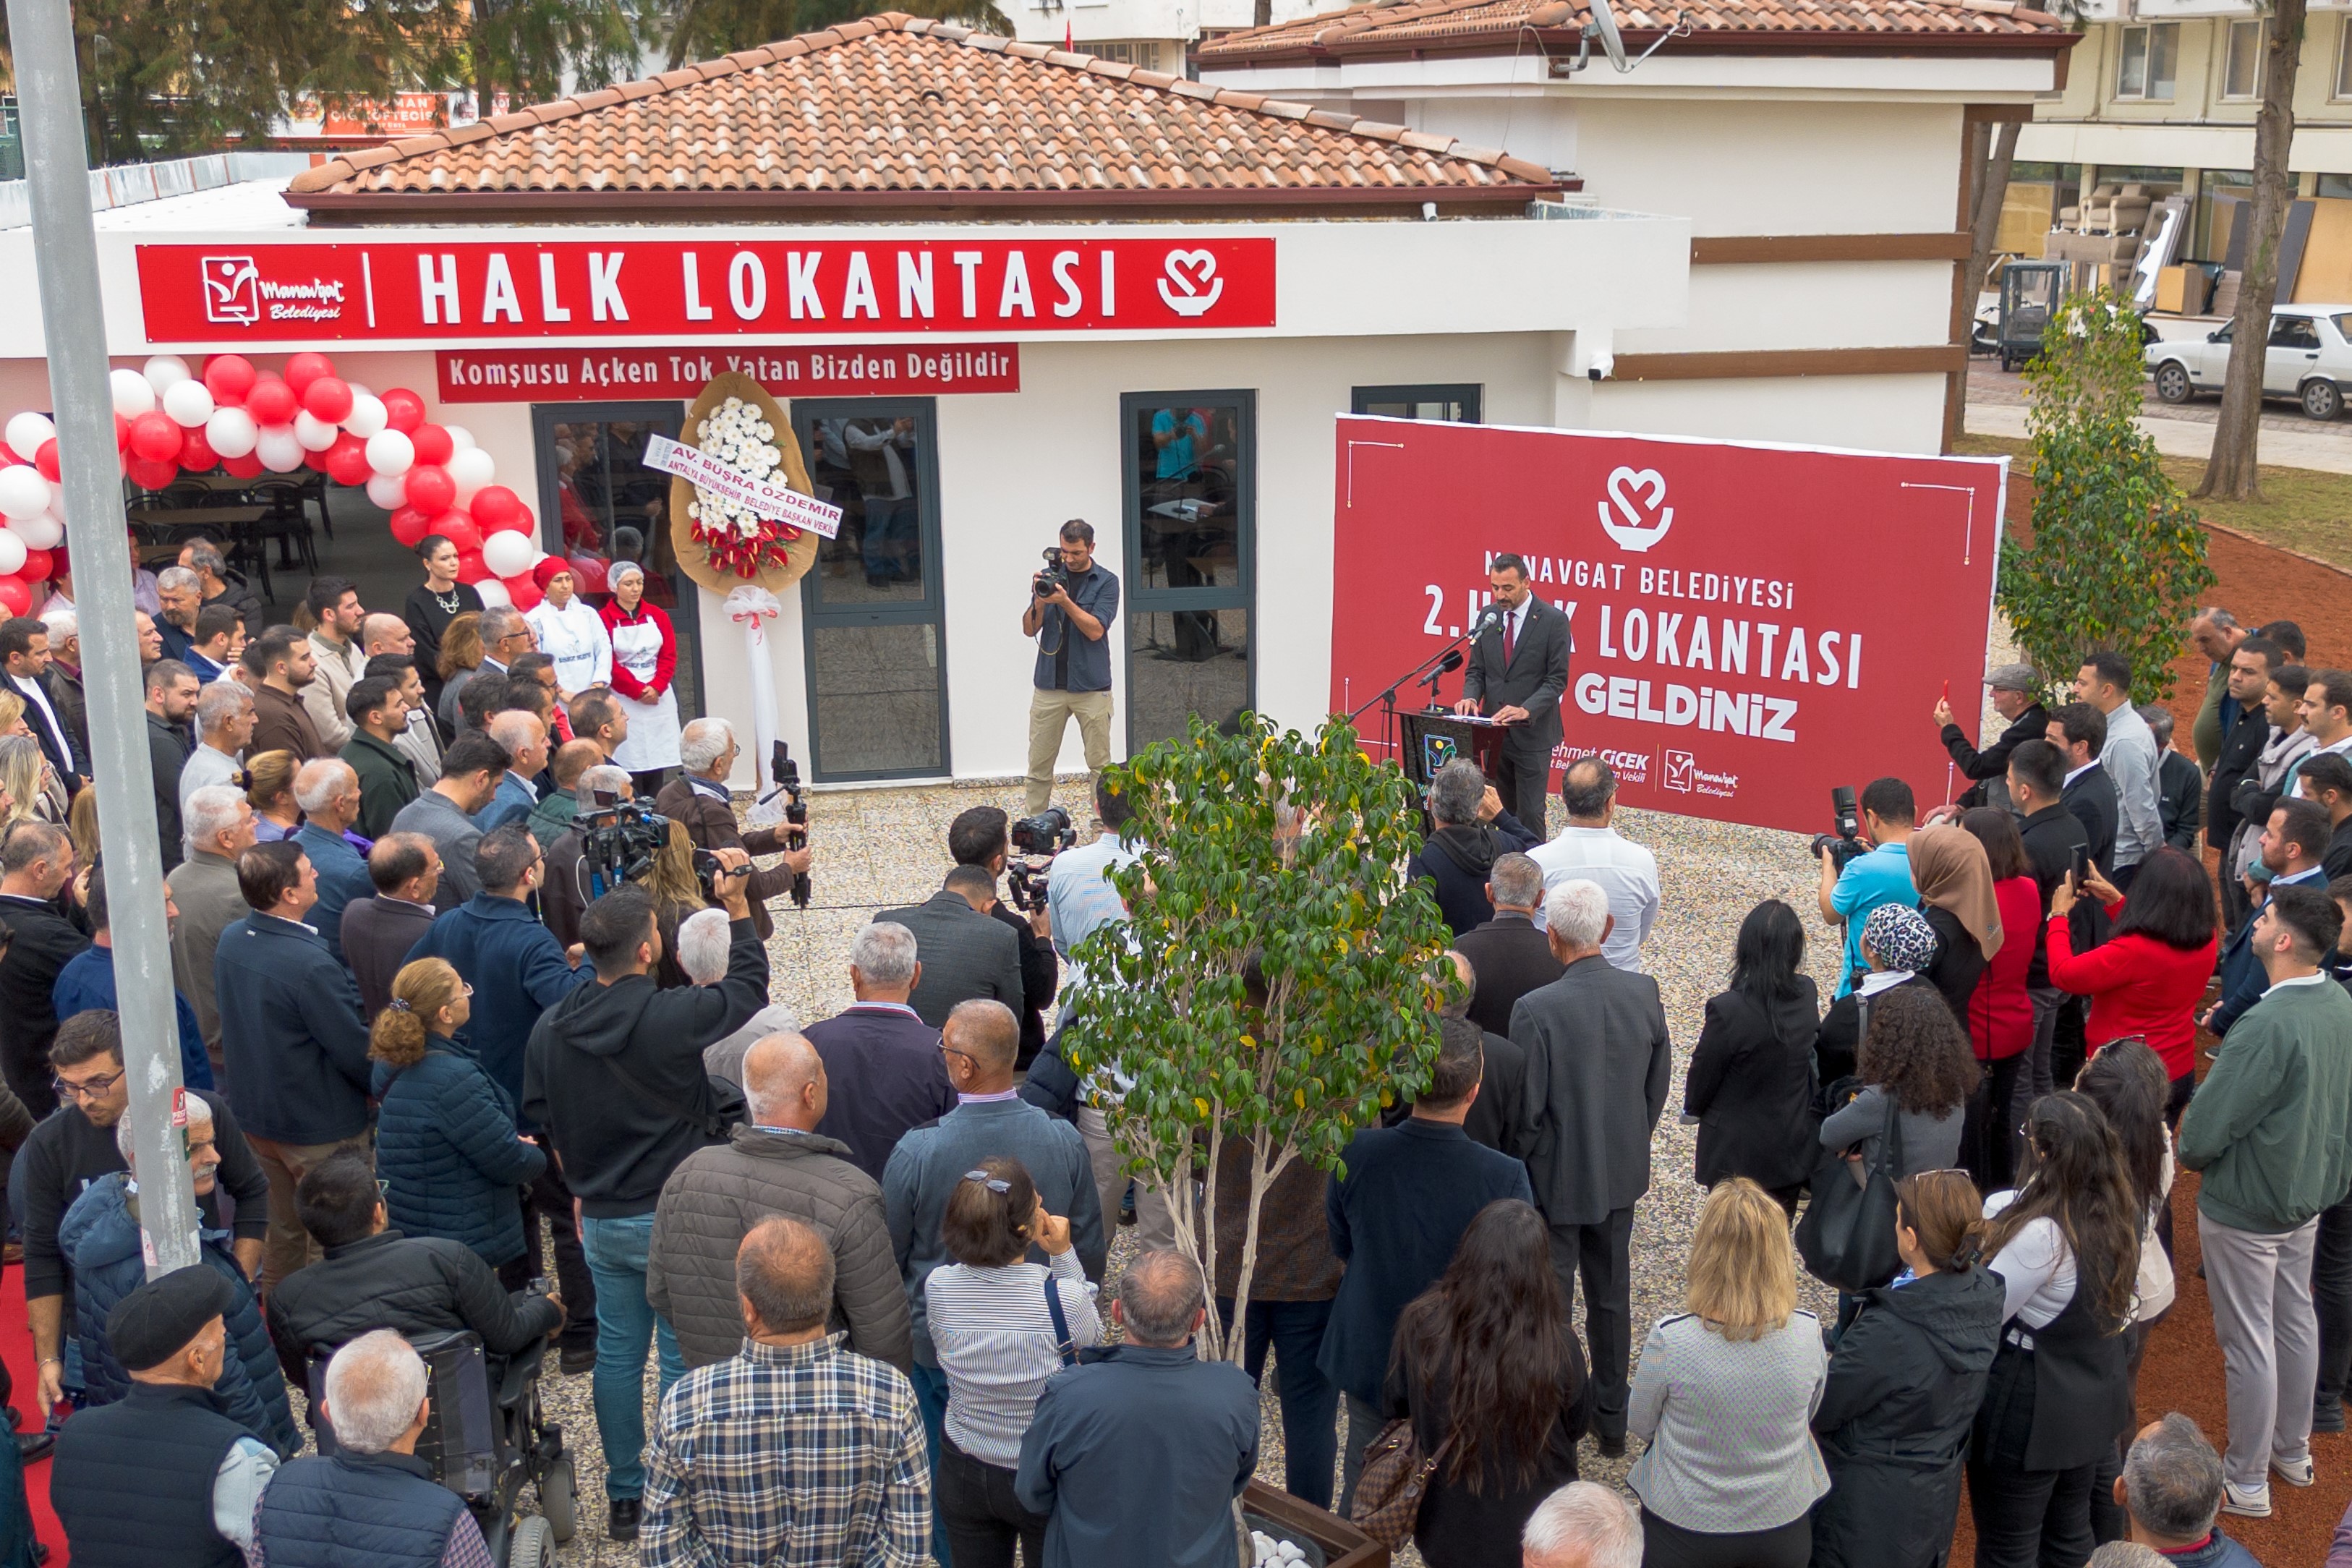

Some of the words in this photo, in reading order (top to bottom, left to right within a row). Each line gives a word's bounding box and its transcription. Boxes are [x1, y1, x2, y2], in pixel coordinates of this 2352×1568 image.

[259, 278, 344, 304] Manavgat
[418, 252, 629, 324] HALK
[682, 250, 1115, 320] LOKANTASI
[269, 304, 341, 323] Belediyesi
[450, 358, 569, 388] Komşusu
[581, 357, 658, 387] Açken
[669, 356, 713, 382] Tok
[811, 353, 897, 380] Bizden
[906, 350, 1010, 383] Değildir
[668, 460, 699, 480] ANTALYA
[699, 473, 742, 502] BÜYÜKŞEHİR
[744, 495, 781, 516] BELEDİYE
[782, 508, 813, 526] BAŞKAN
[673, 446, 697, 463] AV.
[702, 459, 755, 492] BÜŞRA
[762, 485, 840, 521] ÖZDEMİR
[1485, 550, 1626, 590] MNAVGAT
[1599, 605, 1862, 689] LOKANTASI
[1552, 741, 1597, 761] ehmet
